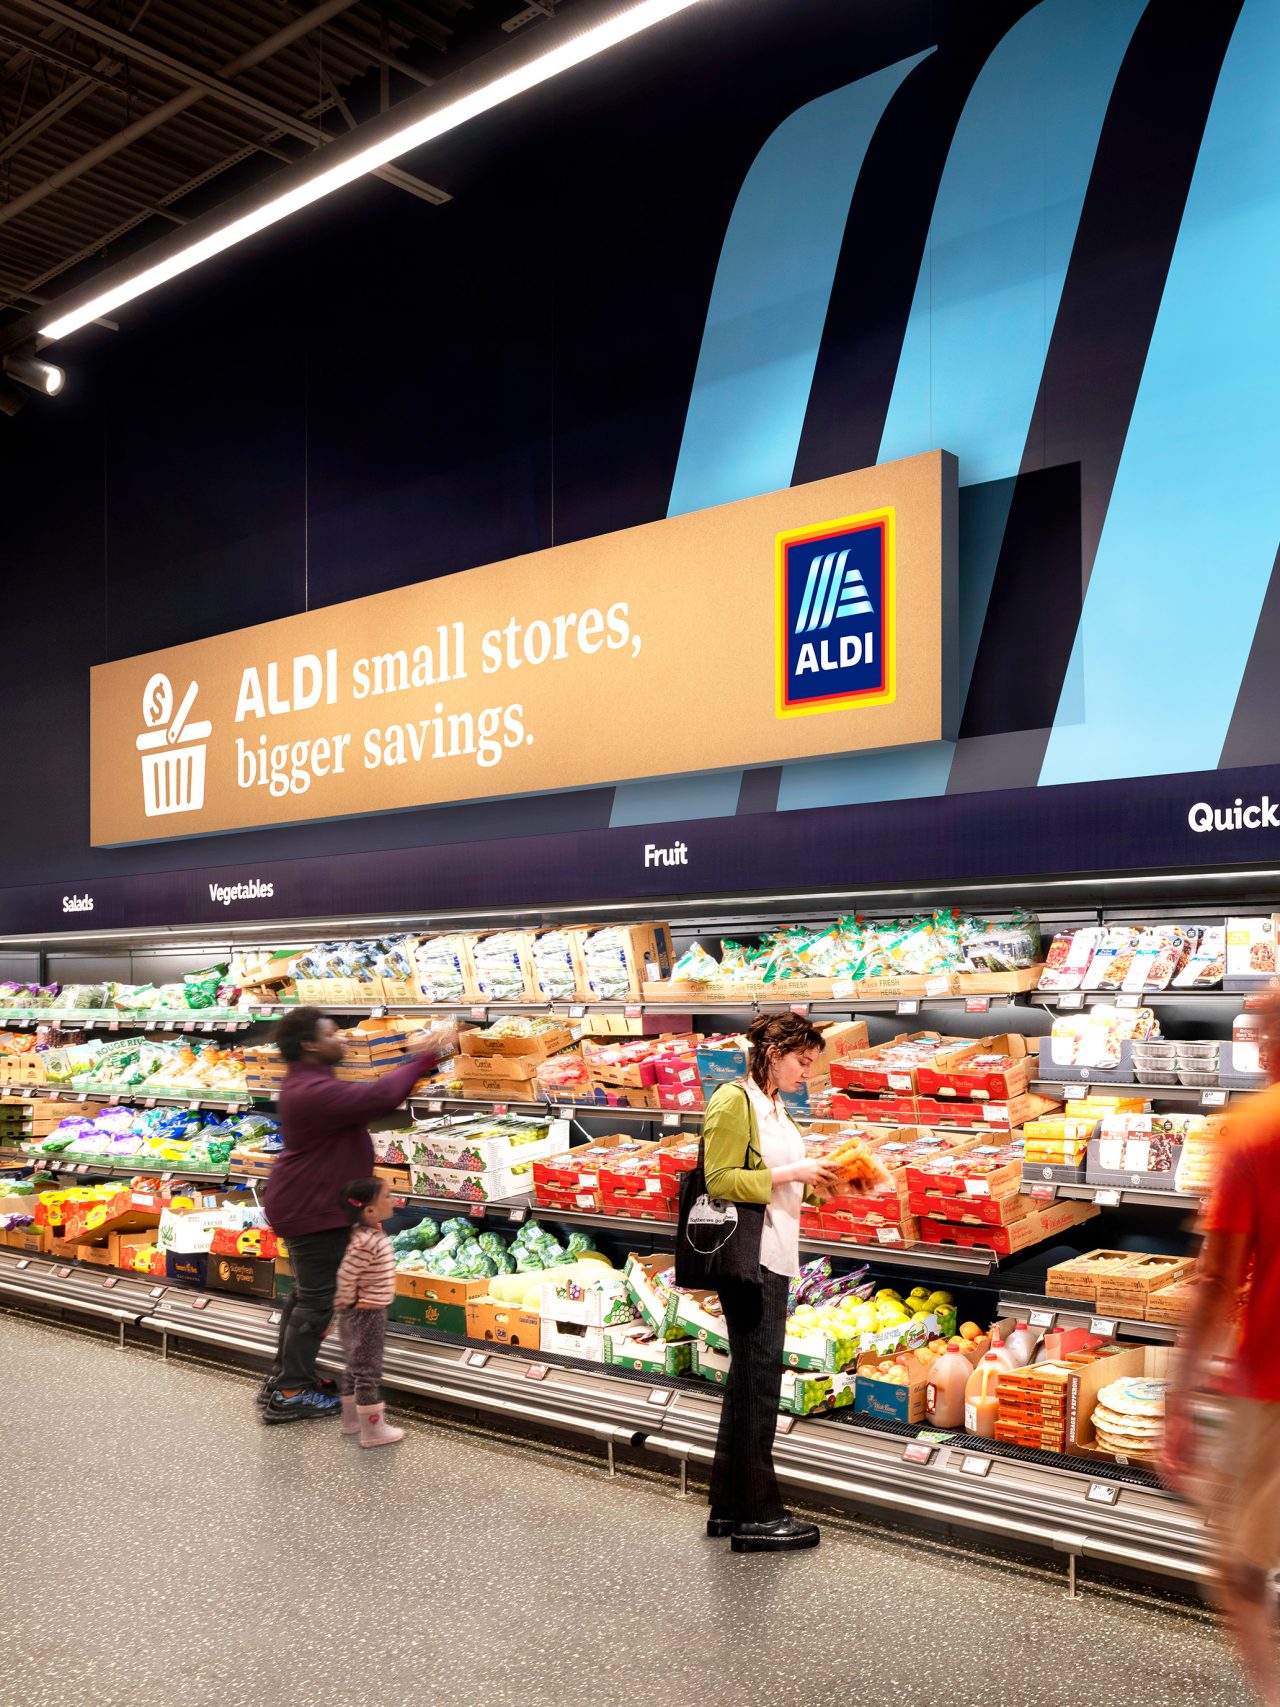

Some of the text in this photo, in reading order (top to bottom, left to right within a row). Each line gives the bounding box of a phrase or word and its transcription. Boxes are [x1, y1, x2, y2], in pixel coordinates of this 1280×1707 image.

[234, 602, 642, 723] ALDI small stores,
[795, 632, 873, 676] ALDI
[235, 702, 535, 797] bigger savings.
[1188, 795, 1280, 833] Quick
[644, 840, 689, 868] Fruit
[62, 893, 94, 913] Salads
[209, 878, 274, 905] Vegetables
[1071, 1377, 1079, 1409] PEPPERONI
